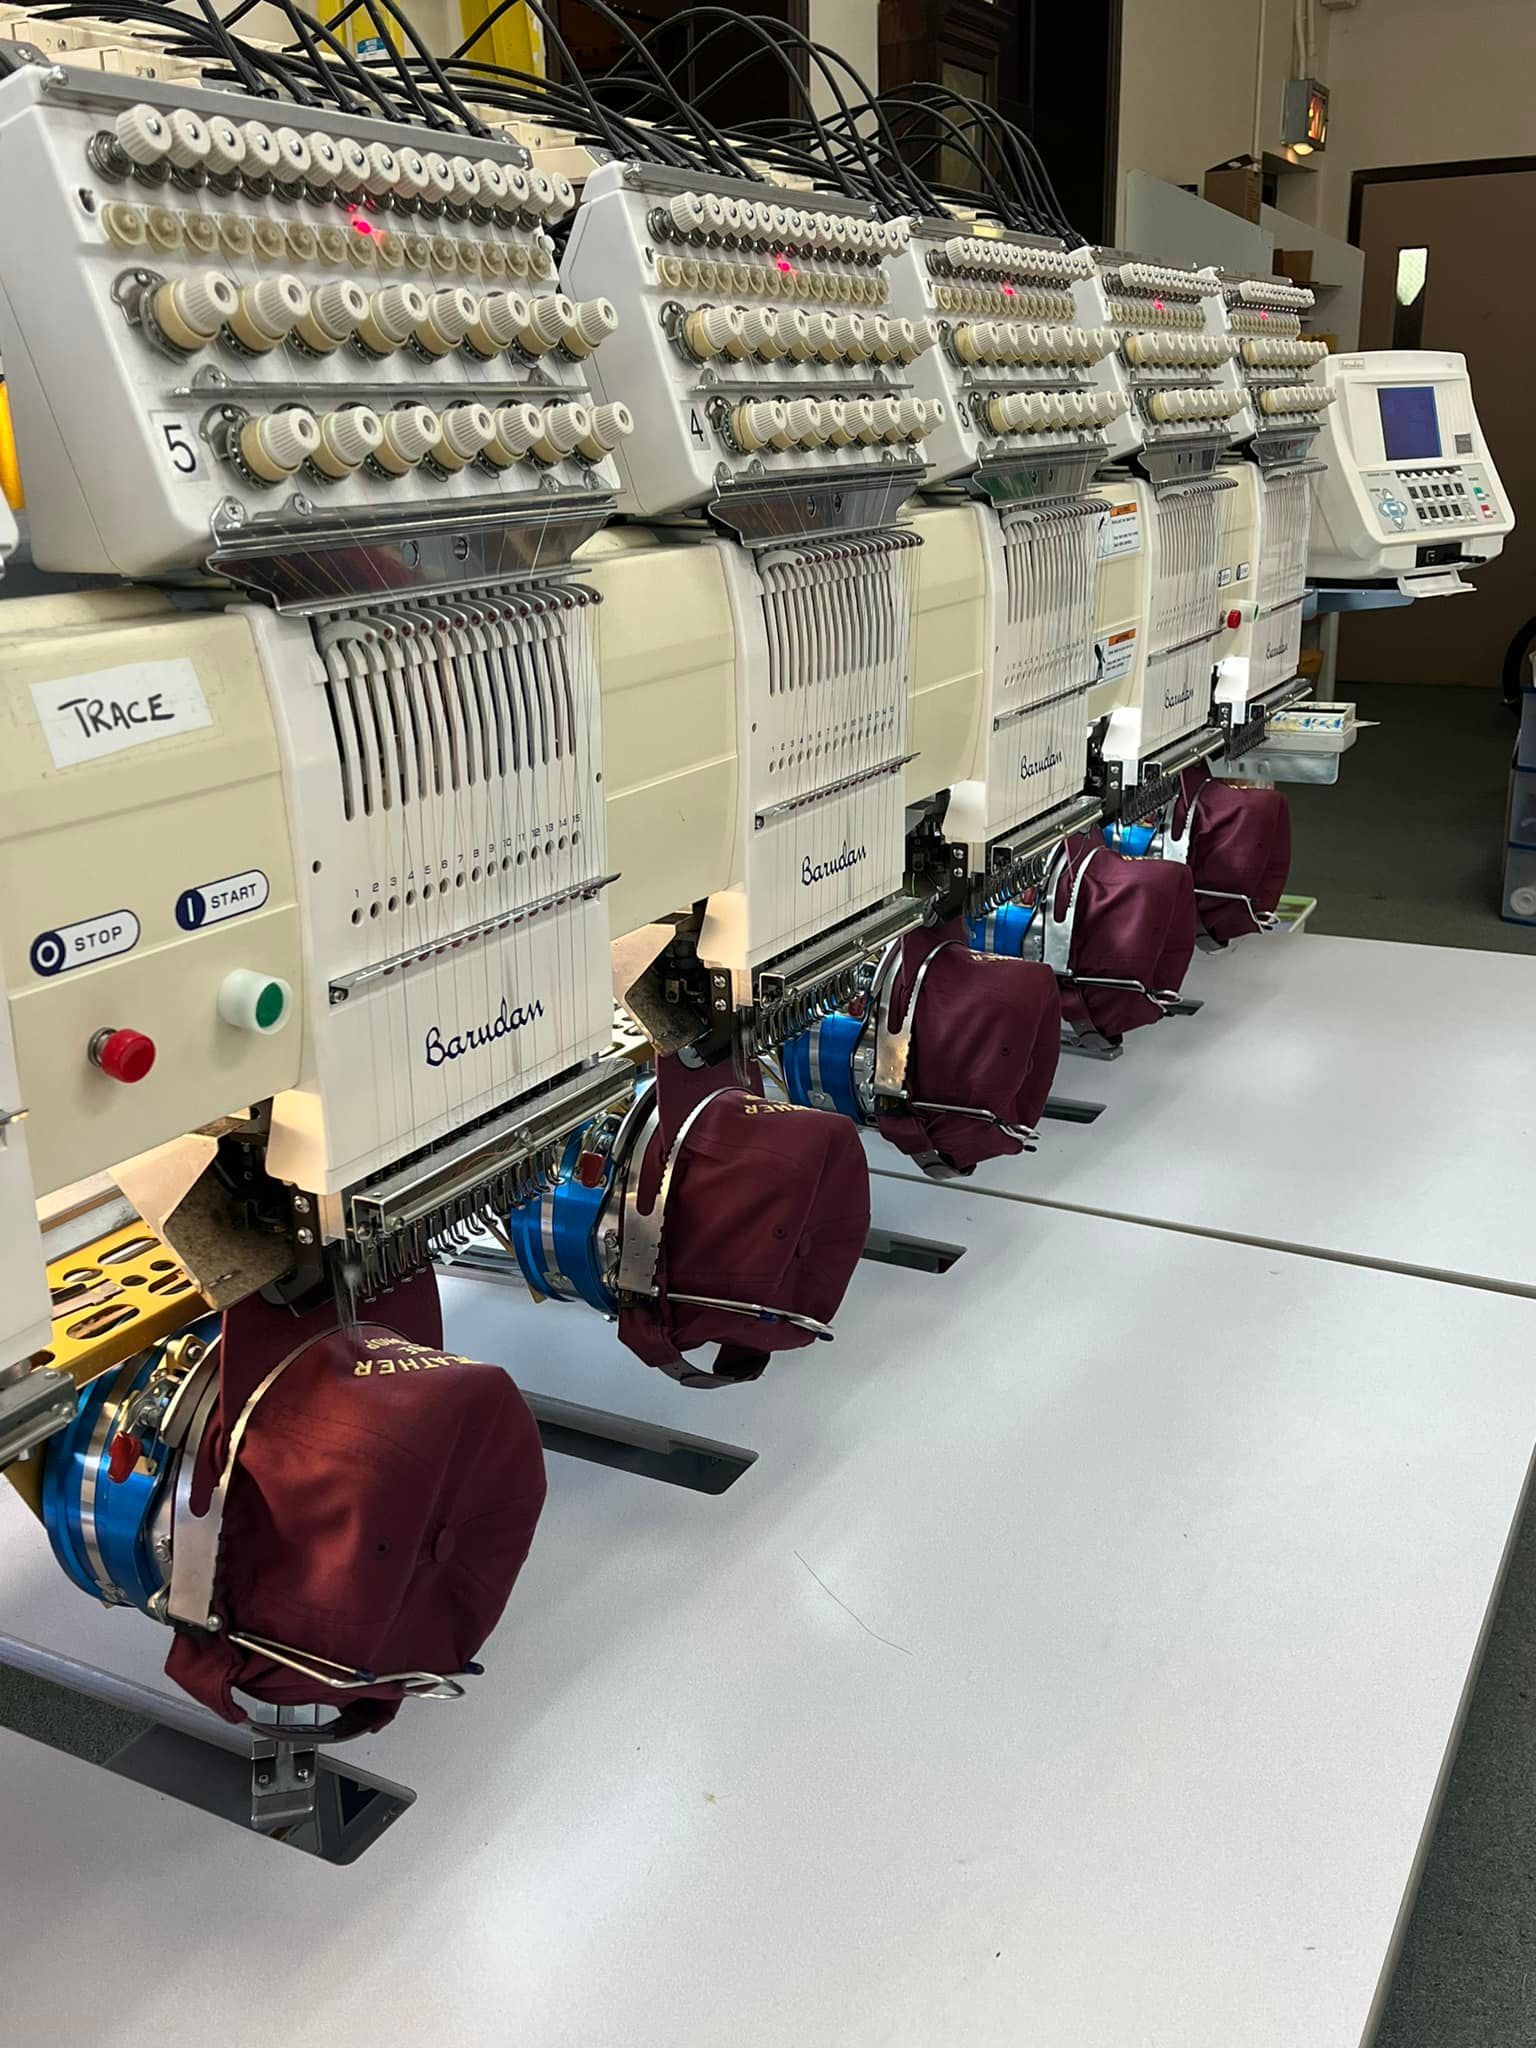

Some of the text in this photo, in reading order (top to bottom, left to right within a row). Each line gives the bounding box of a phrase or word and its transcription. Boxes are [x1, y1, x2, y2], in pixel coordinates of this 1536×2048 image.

[691, 408, 704, 442] 4
[957, 401, 969, 428] 3
[163, 424, 197, 473] 5
[57, 693, 175, 738] TRACE
[1020, 745, 1062, 780] Barudan
[372, 883, 379, 892] 2
[390, 877, 397, 886] 3
[424, 865, 431, 874] 5
[441, 860, 448, 869] 6
[458, 854, 464, 863] 7
[473, 849, 479, 858] 8
[488, 844, 495, 853] 9
[502, 838, 511, 847] 10
[531, 828, 541, 837] 12
[545, 823, 554, 832] 13
[801, 839, 866, 886] Barudan
[210, 883, 257, 909] START
[74, 925, 123, 952] STOP
[425, 996, 544, 1067] Barudan
